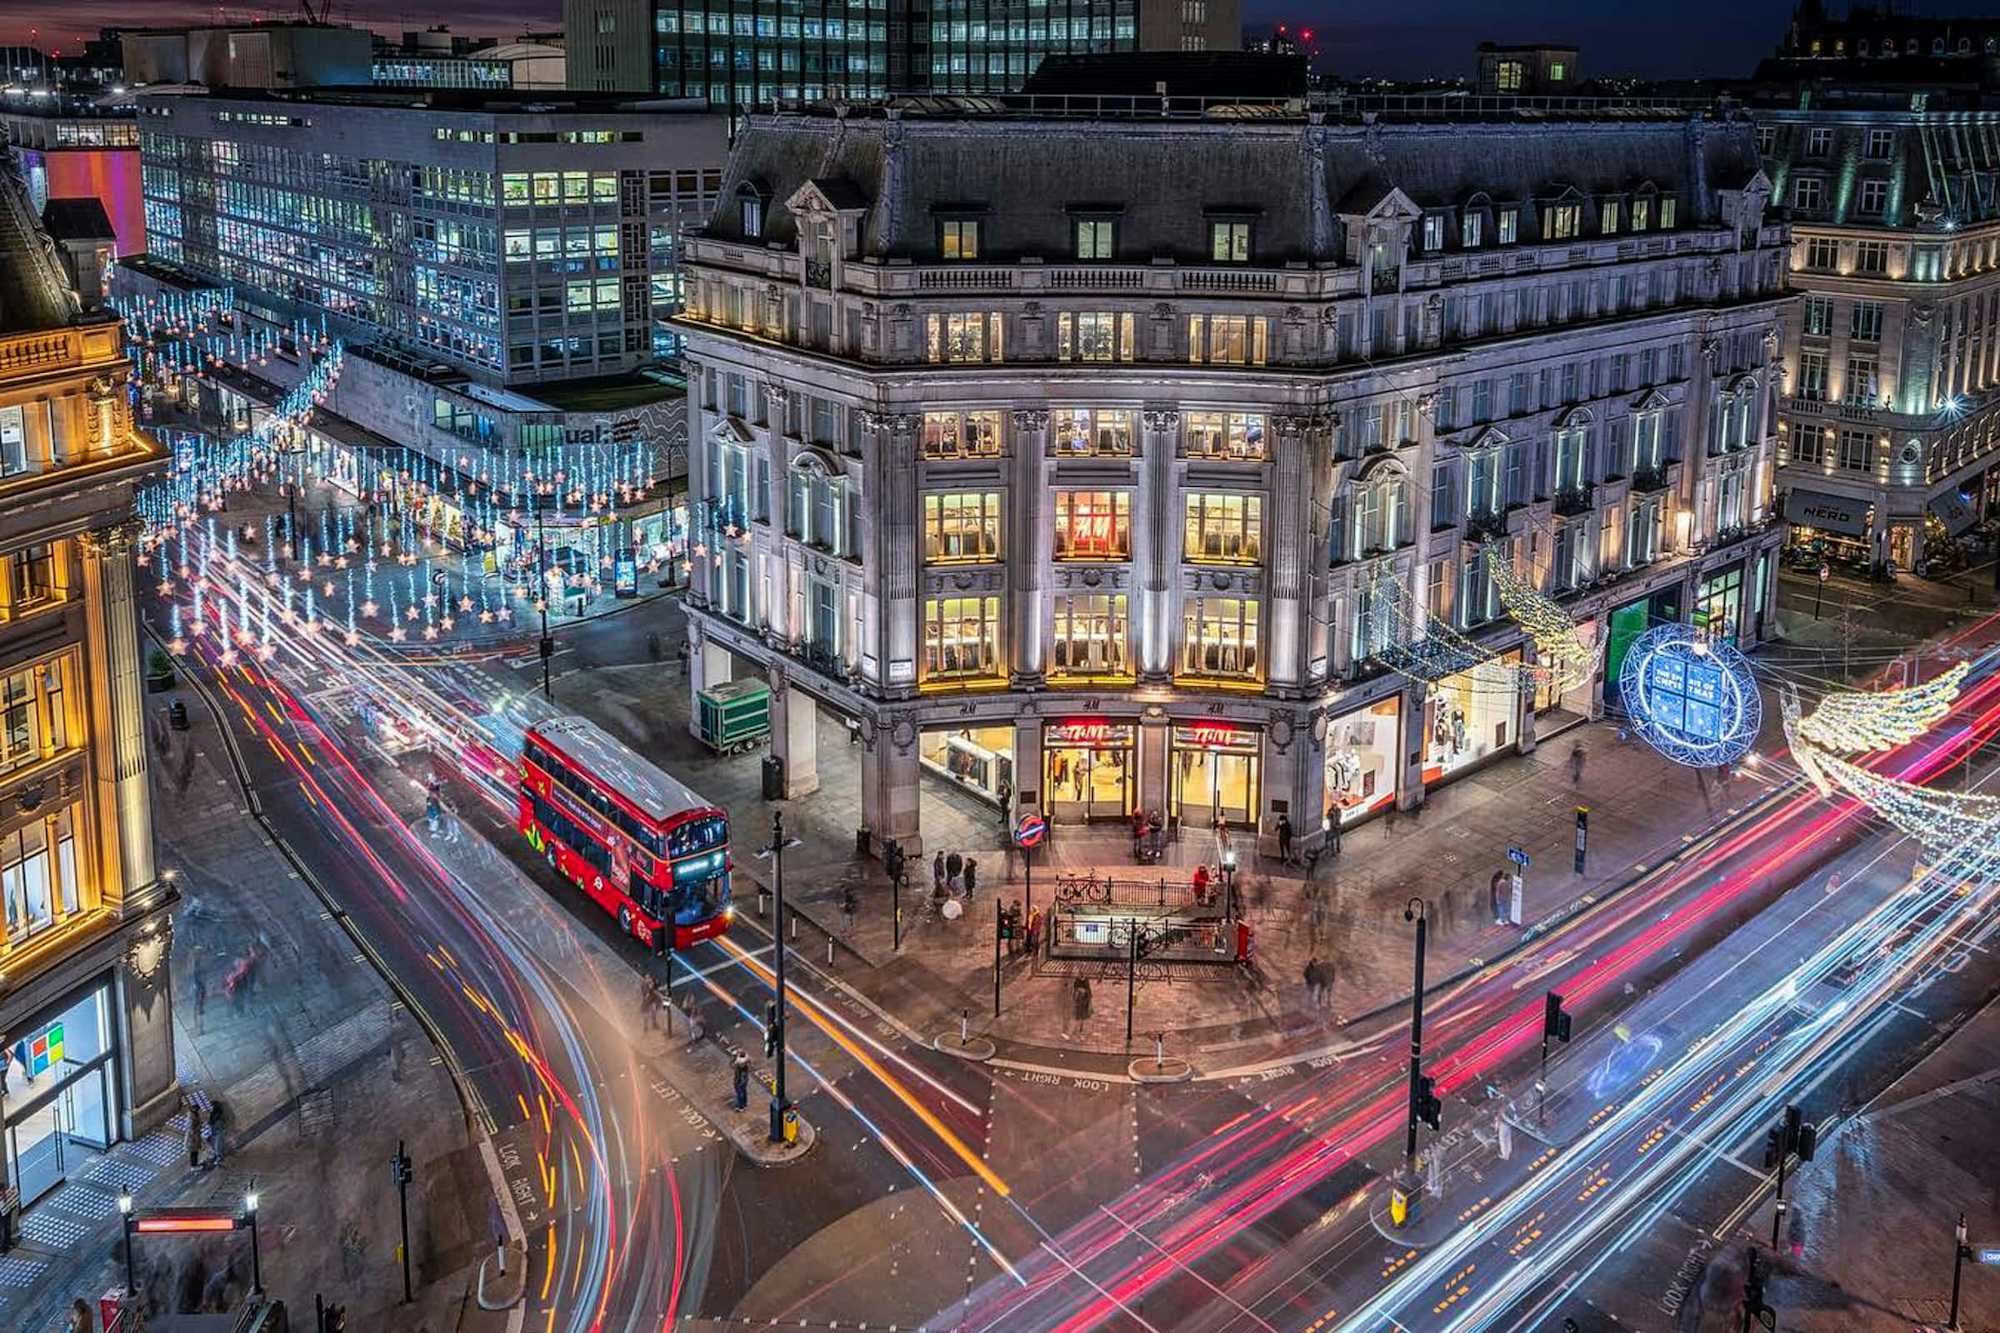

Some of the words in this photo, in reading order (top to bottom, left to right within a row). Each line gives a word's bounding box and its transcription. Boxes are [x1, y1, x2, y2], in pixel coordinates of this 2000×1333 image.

[1804, 507, 1849, 522] NERO
[1021, 1071, 1060, 1086] RIGHT
[1073, 1078, 1109, 1092] LOOK
[651, 1080, 680, 1101] LEFT
[681, 1105, 709, 1129] LOOK
[499, 1143, 521, 1169] LOOK
[512, 1177, 536, 1205] RIGHT
[1658, 1281, 1688, 1317] LOOK
[1677, 1248, 1706, 1282] RIGHT
